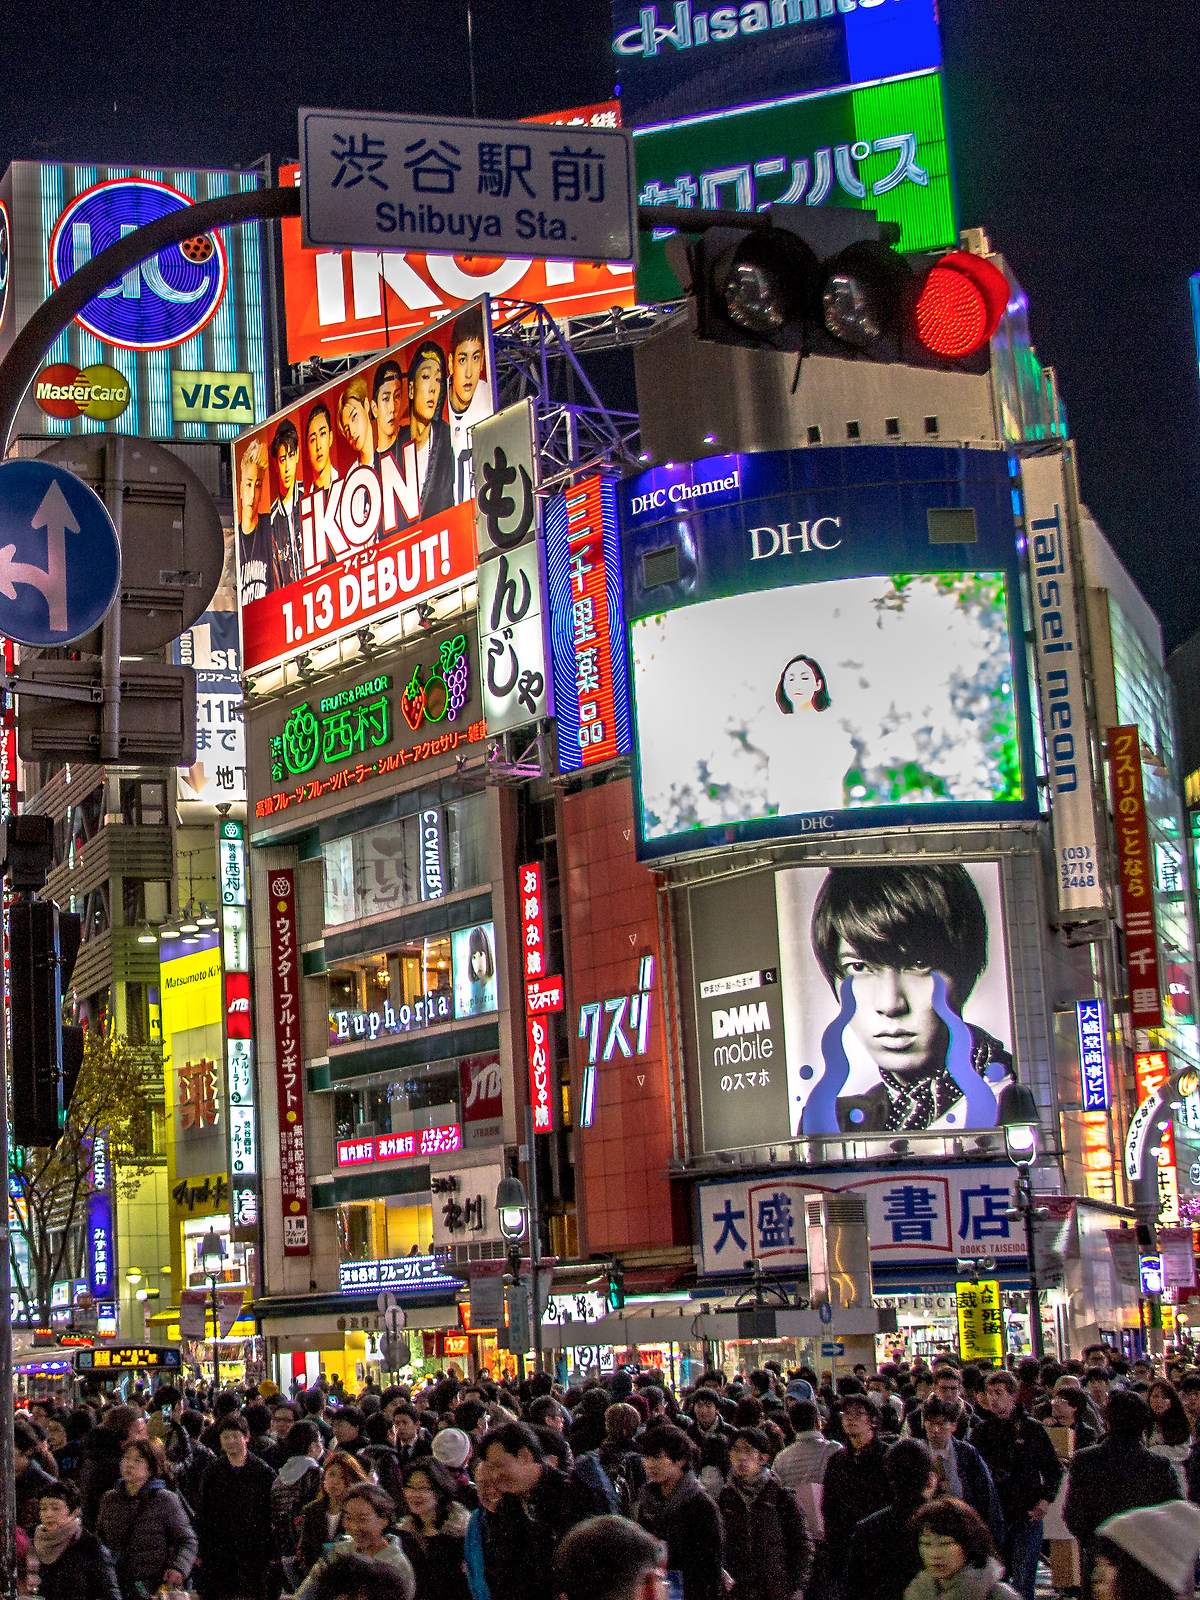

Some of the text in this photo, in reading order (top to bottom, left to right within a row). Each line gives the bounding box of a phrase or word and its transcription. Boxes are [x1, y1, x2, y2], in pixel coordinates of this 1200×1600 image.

[330, 132, 606, 203] 渋谷駅前
[375, 201, 578, 242] Shibuya Sta.
[36, 382, 130, 403] MasterCard
[180, 384, 252, 411] VISA
[300, 441, 421, 571] iKON
[631, 471, 740, 515] DHC Channel
[749, 517, 842, 561] DHC
[342, 549, 378, 574] アイコン
[478, 446, 544, 715] もんじゃ
[282, 585, 334, 644] 1.13
[340, 530, 451, 620] DEBUT!
[565, 493, 604, 748] 三千里薬品
[1030, 503, 1078, 794] Taisei neon
[270, 737, 282, 782] 渋谷
[801, 816, 834, 831] DHC
[1061, 860, 1094, 875] 3719
[1062, 846, 1091, 861] (03)
[1062, 874, 1095, 890] 2468
[1114, 735, 1160, 1014] クスリのことなら 三千里
[524, 871, 542, 974] お好み焼
[164, 969, 207, 990] Matsumoto
[228, 998, 249, 1013] JTB
[276, 917, 297, 1107] ウィンターフルーツギフト
[337, 991, 448, 1039] Euphoria
[711, 1001, 771, 1040] DMM
[241, 1053, 250, 1086] フルーツ
[714, 1033, 773, 1067] mobile
[177, 1057, 220, 1129] 薬
[721, 1068, 770, 1092] のスマホ
[234, 1125, 242, 1158] フルーツ
[379, 1136, 414, 1156] 海外旅行
[422, 1126, 456, 1141] ハネムーン
[293, 1125, 306, 1199] 無料配送地域
[94, 1228, 107, 1285] みずほ銀行
[960, 1244, 987, 1255] BOOKS
